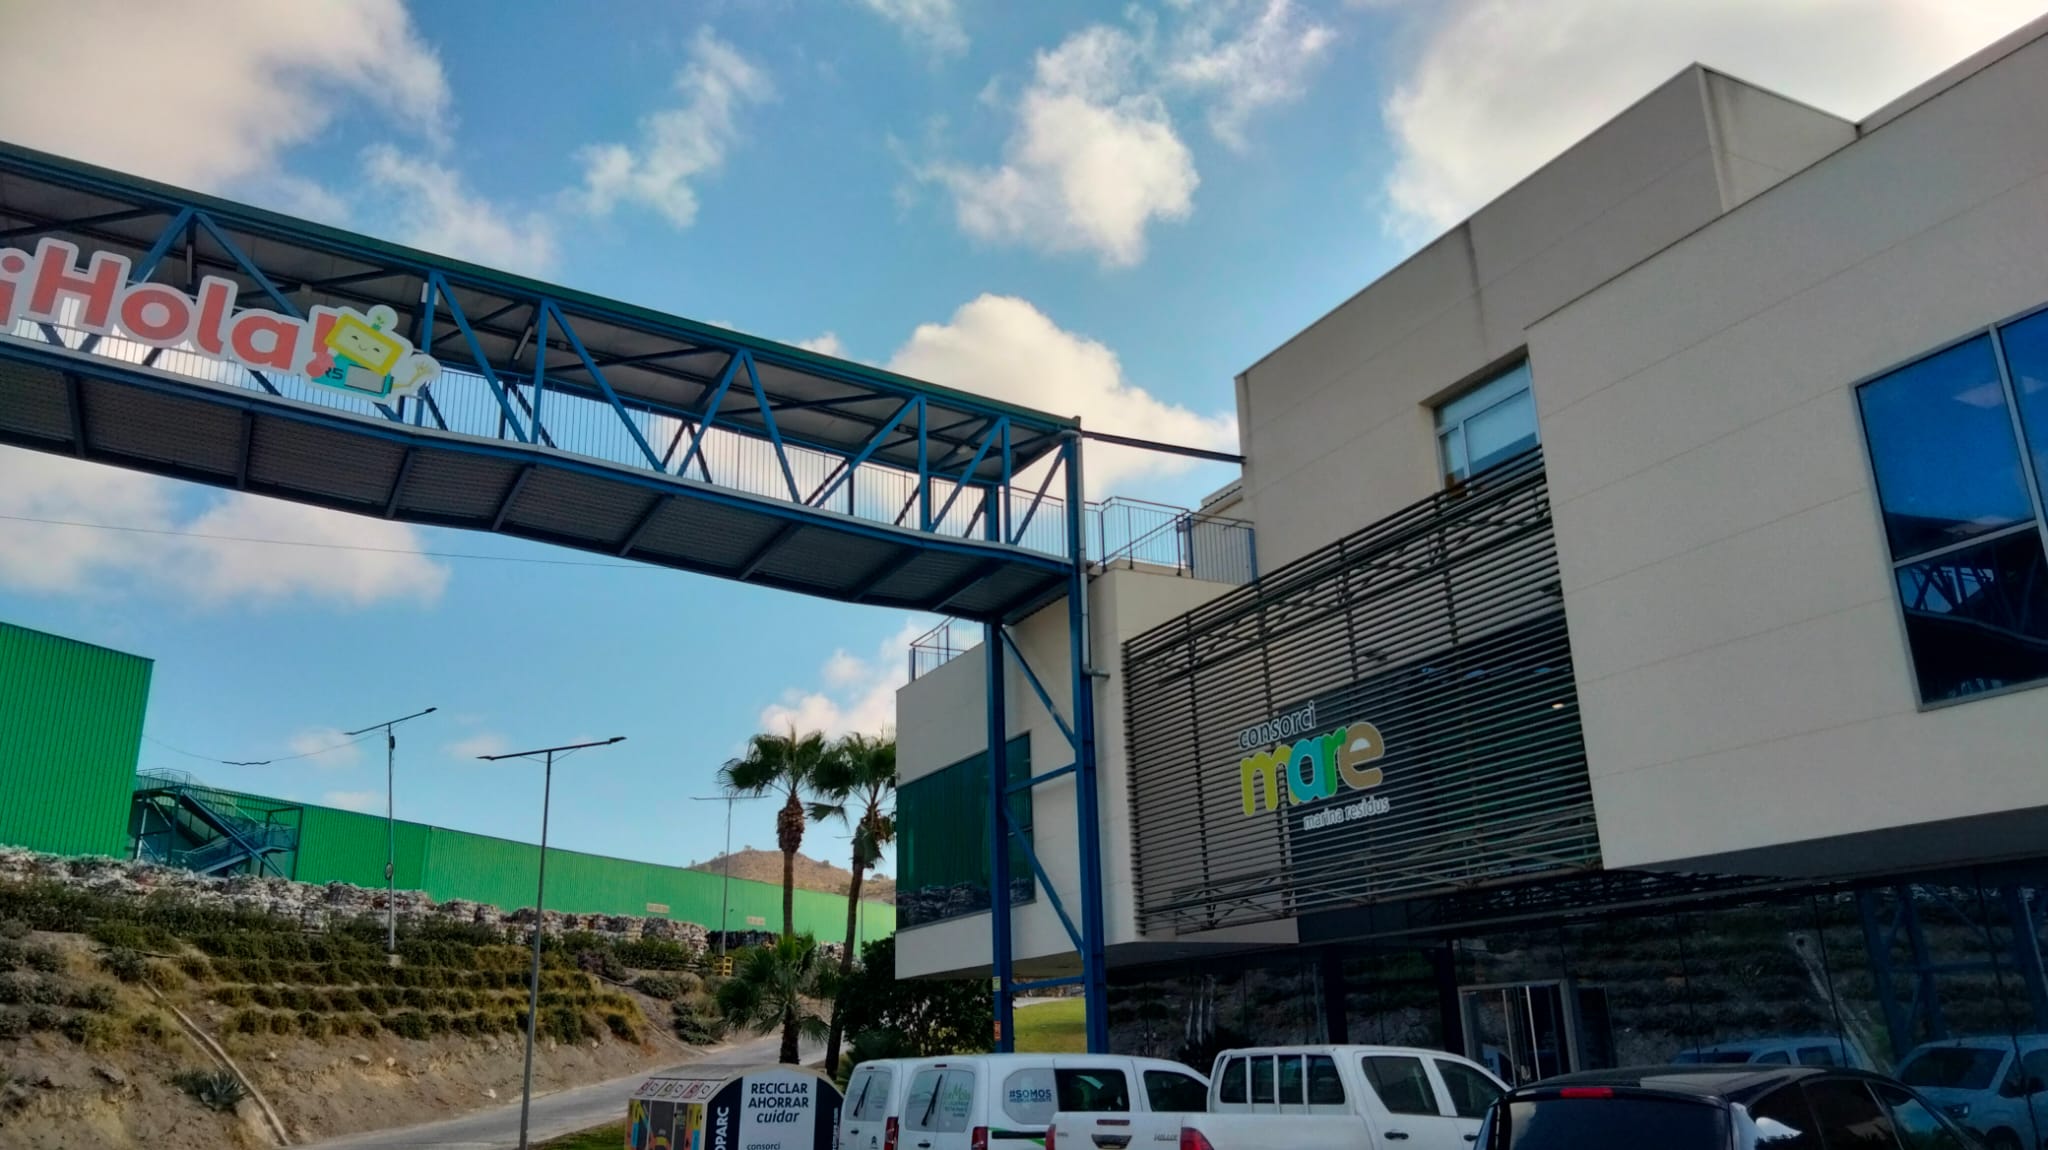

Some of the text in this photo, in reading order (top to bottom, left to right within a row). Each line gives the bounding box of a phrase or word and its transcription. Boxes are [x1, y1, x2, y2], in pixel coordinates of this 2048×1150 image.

[1239, 700, 1316, 749] consorci
[1240, 722, 1385, 816] mare
[1303, 795, 1391, 830] marina residus
[751, 1082, 808, 1095] RECICLAR
[1009, 1089, 1052, 1098] #SOMOS
[748, 1096, 809, 1109] AHORRAR
[756, 1109, 800, 1123] cuidar
[747, 1141, 781, 1150] consorci
